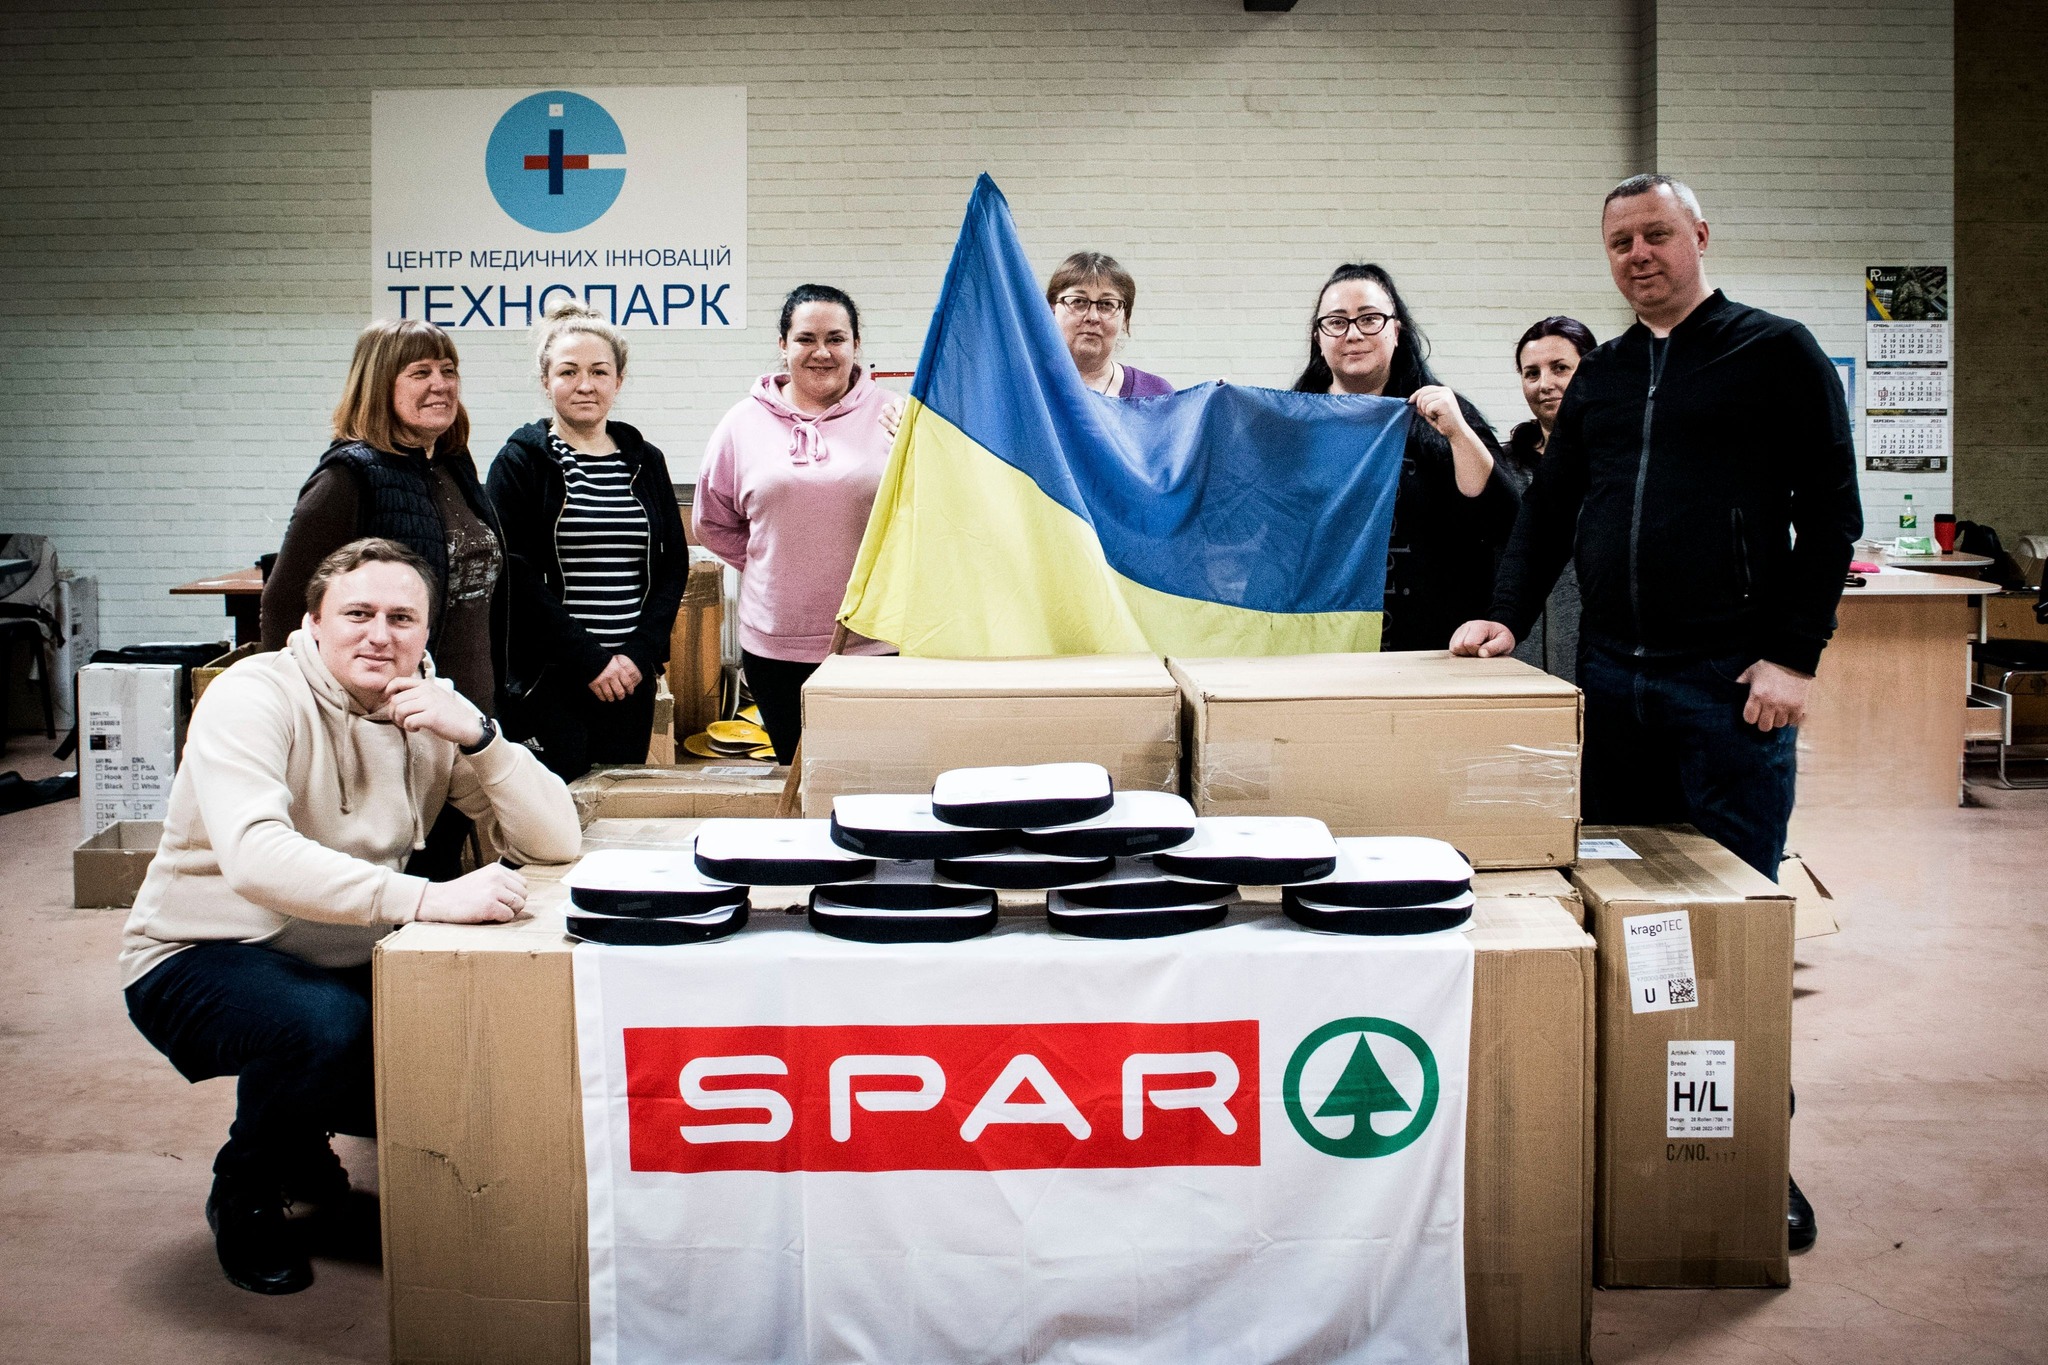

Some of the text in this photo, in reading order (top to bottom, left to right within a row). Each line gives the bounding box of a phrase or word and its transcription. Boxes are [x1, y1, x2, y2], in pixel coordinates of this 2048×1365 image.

[387, 245, 732, 272] ЦЕНТР МЕДИЧНИХ ІННОВАЦІЙ
[1630, 918, 1683, 937] kragoTEC
[1644, 987, 1656, 1003] U
[679, 1051, 1240, 1144] SPAR
[1674, 1080, 1728, 1112] H/L
[1666, 1143, 1710, 1161] C/NO.
